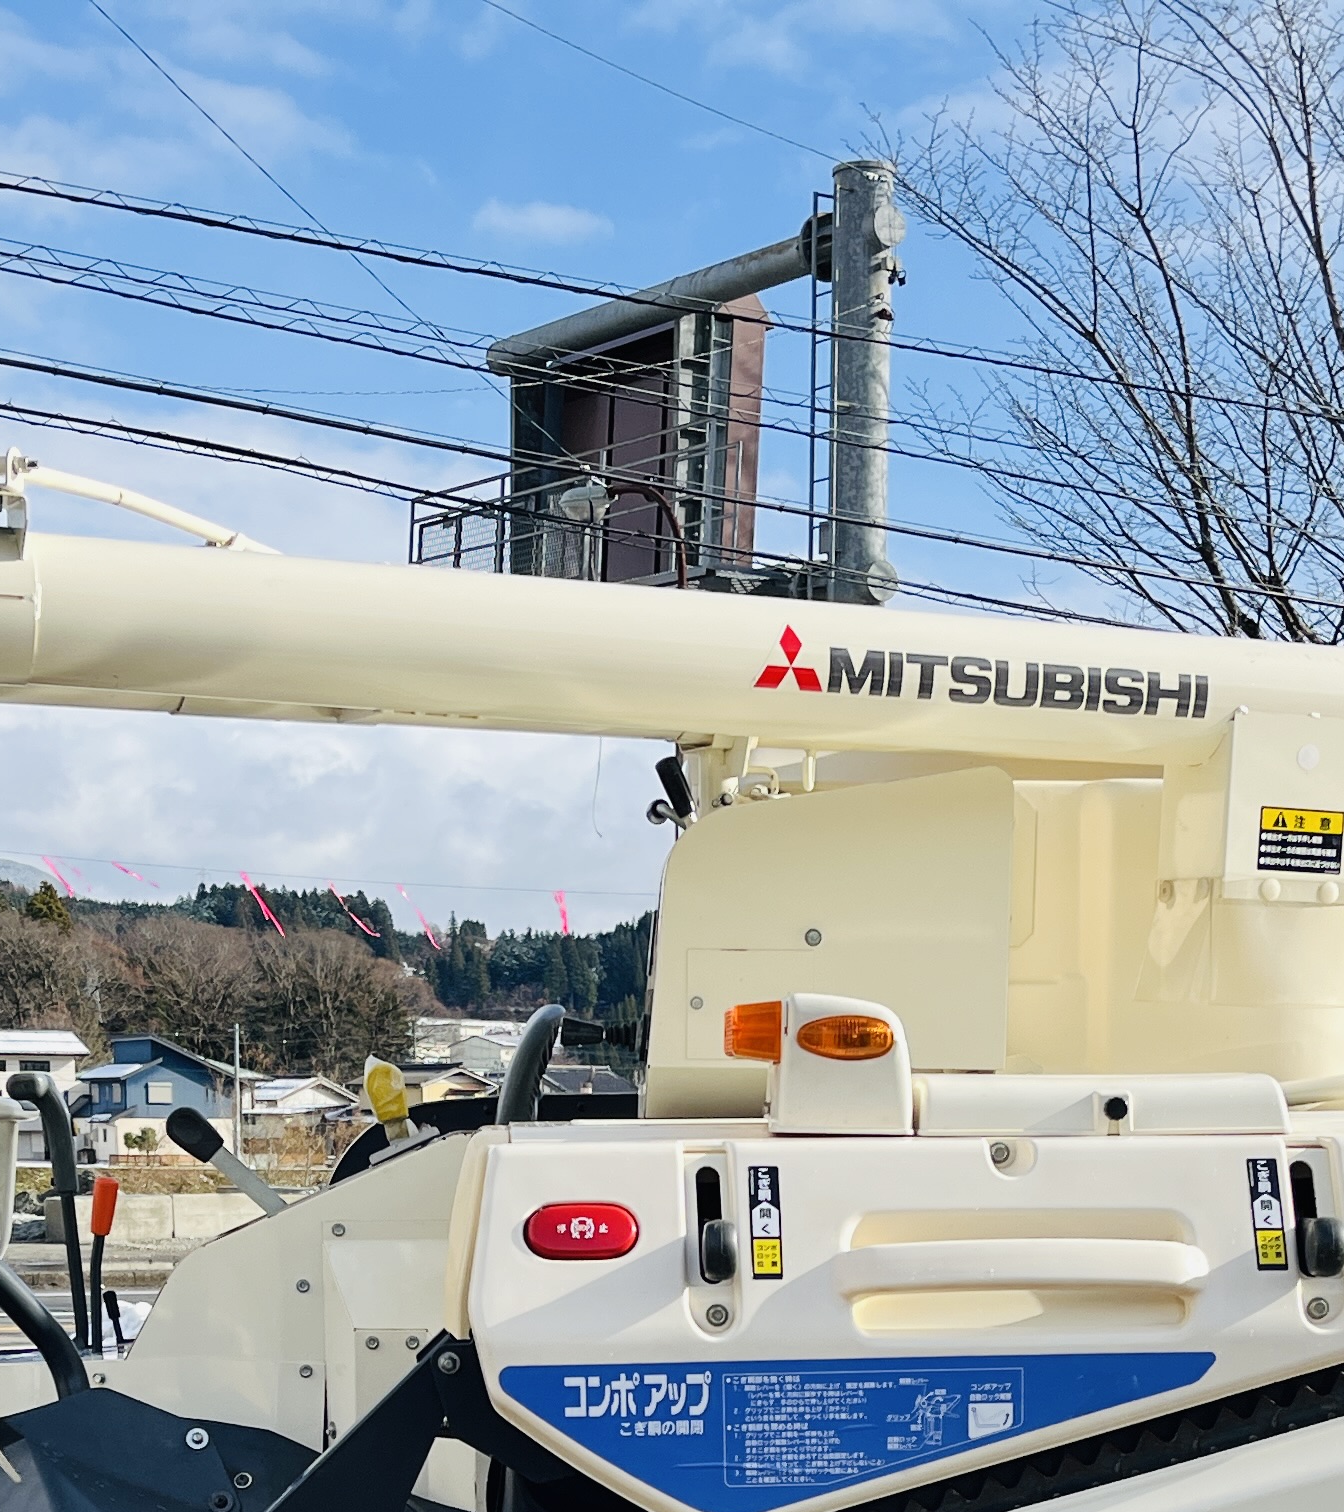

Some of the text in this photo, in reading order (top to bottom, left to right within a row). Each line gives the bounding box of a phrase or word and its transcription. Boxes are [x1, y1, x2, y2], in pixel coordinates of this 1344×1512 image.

[827, 646, 1209, 718] MITSUBISHI
[563, 1370, 712, 1418] コンポアップ
